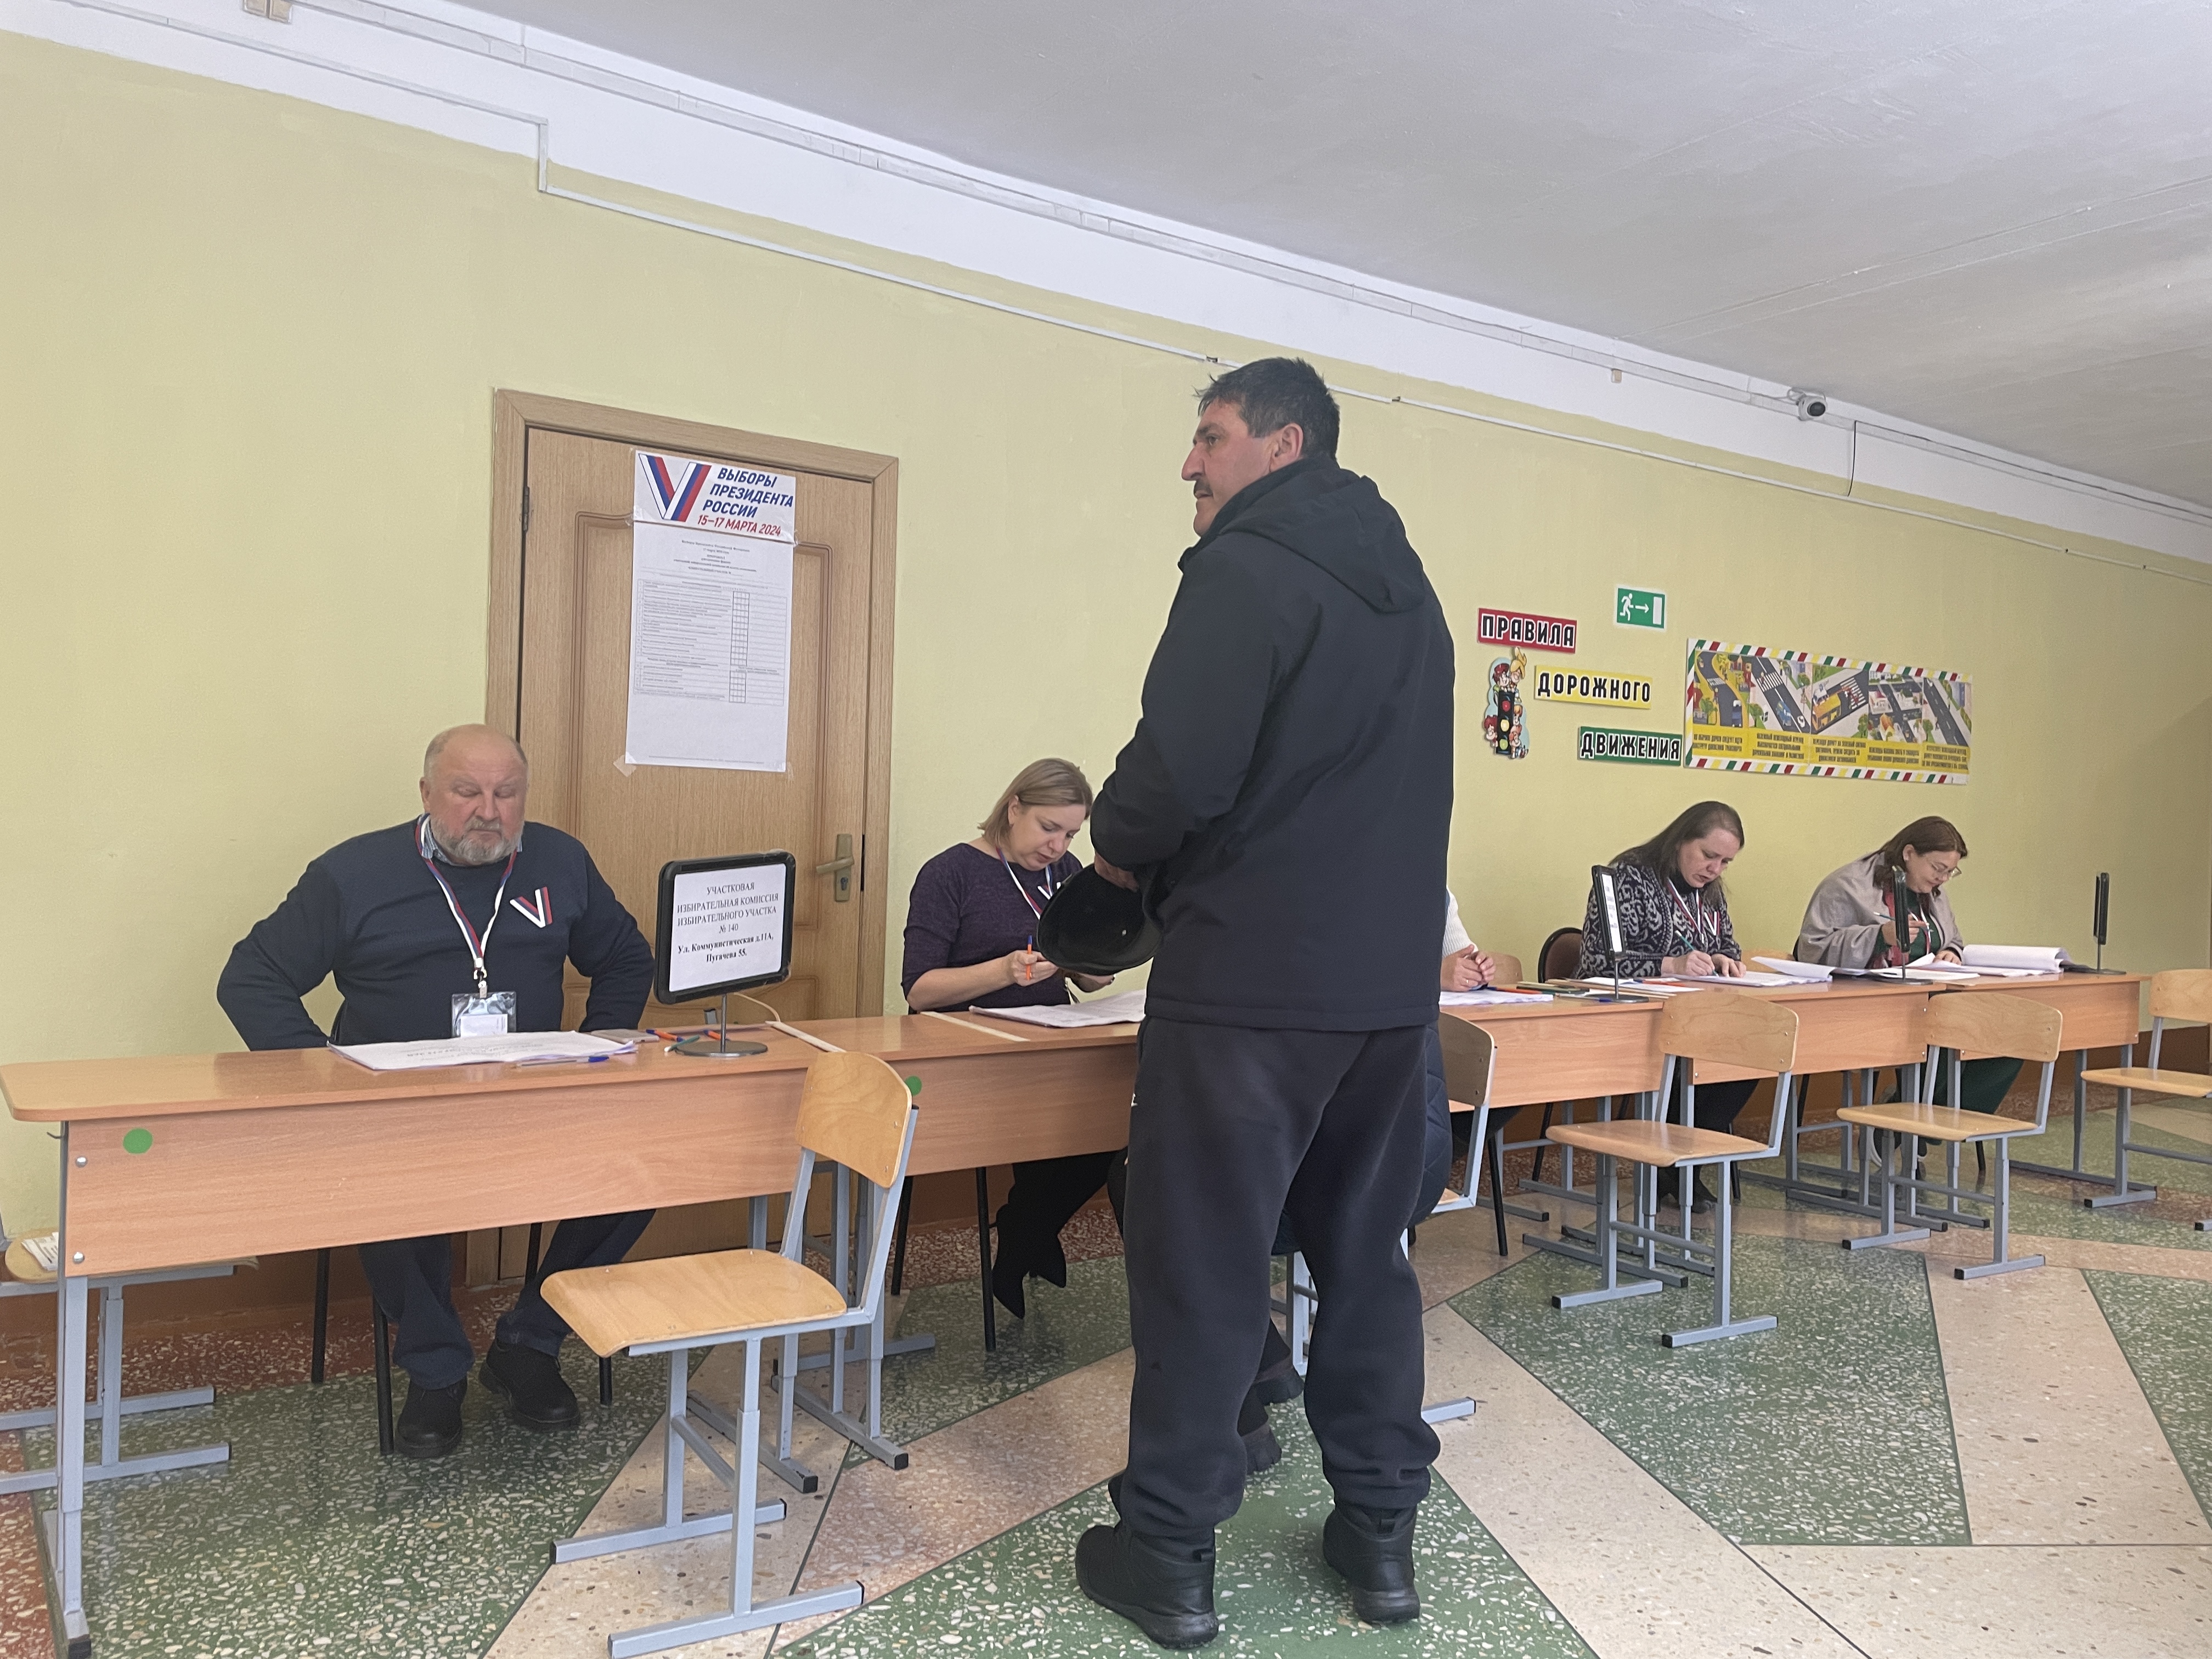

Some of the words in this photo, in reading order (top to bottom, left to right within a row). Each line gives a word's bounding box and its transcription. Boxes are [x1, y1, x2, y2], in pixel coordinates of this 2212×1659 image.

[718, 467, 777, 488] ВЫБОРЫ
[709, 483, 794, 507] ПРЕЗИДЕНТА
[702, 499, 758, 518] РОССИИ
[725, 518, 757, 533] МАРТА
[759, 524, 781, 537] 2024
[1482, 614, 1574, 647] ПРАВИЛА
[1538, 673, 1650, 702] ДОРОЖНОГО
[1581, 732, 1680, 760] ДВИЖЕНИЯ
[707, 882, 754, 895] УЧАСТКОВАЯ
[677, 898, 739, 913] ИЗБИРАТЕЛЬНАЯ
[741, 893, 778, 905] КОМИССИЯ
[678, 910, 743, 927] ИЗБИРАТЕЛЬНОГО
[745, 906, 776, 917] УЧАСТКА
[728, 923, 738, 932] 140
[678, 945, 690, 954] Ул.
[691, 936, 754, 951] Коммунистическая
[706, 952, 737, 963] Пугачева
